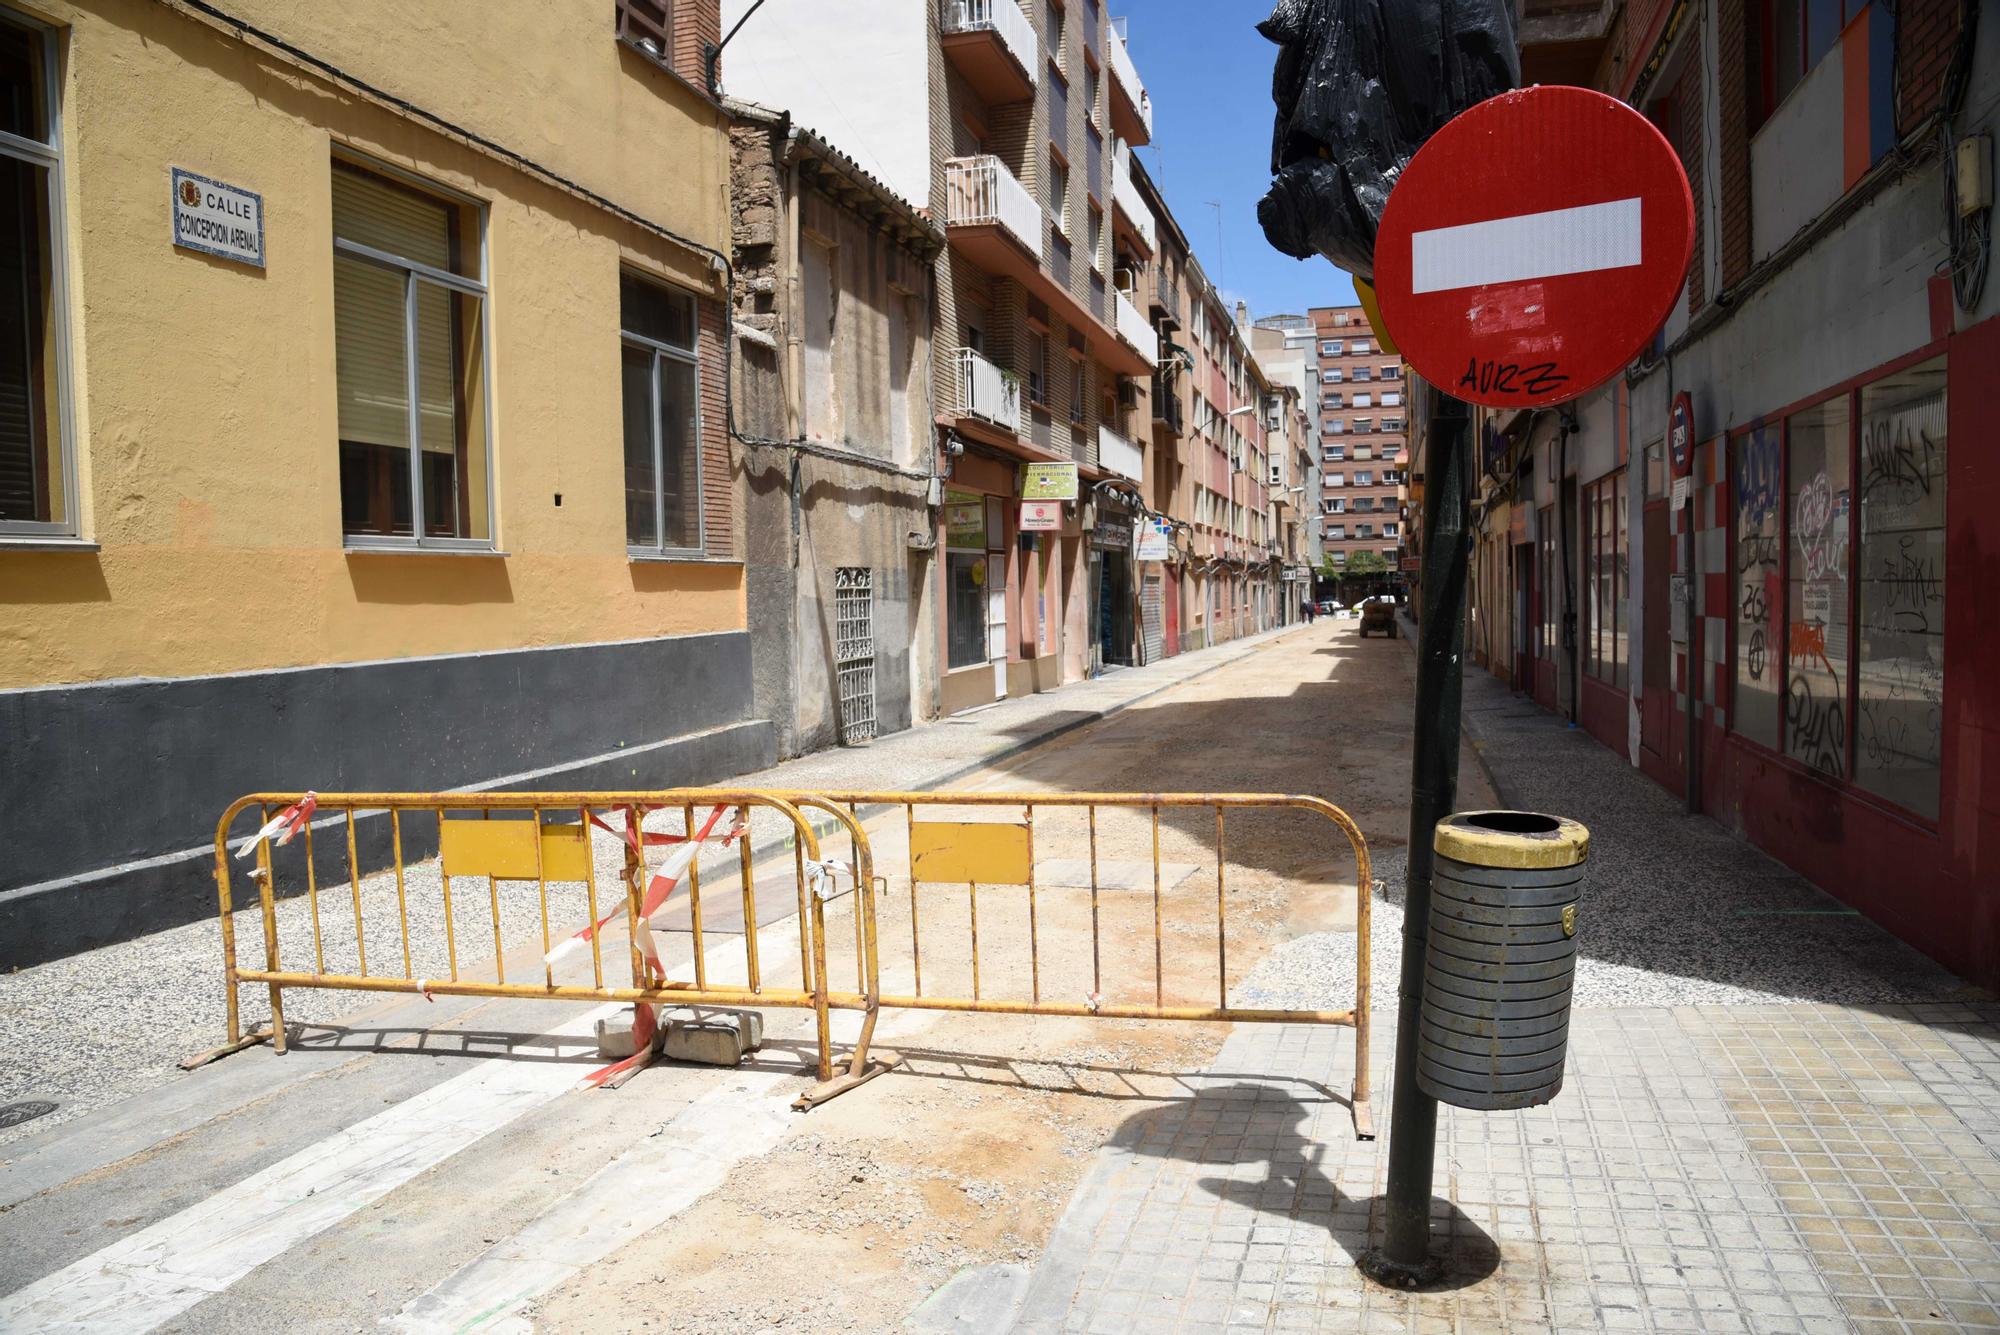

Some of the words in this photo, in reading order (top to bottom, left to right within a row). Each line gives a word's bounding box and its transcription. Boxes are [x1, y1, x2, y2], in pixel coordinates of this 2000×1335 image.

[206, 193, 251, 220] CALLE
[179, 212, 229, 245] CONCEPCION
[230, 224, 258, 253] ARENAL
